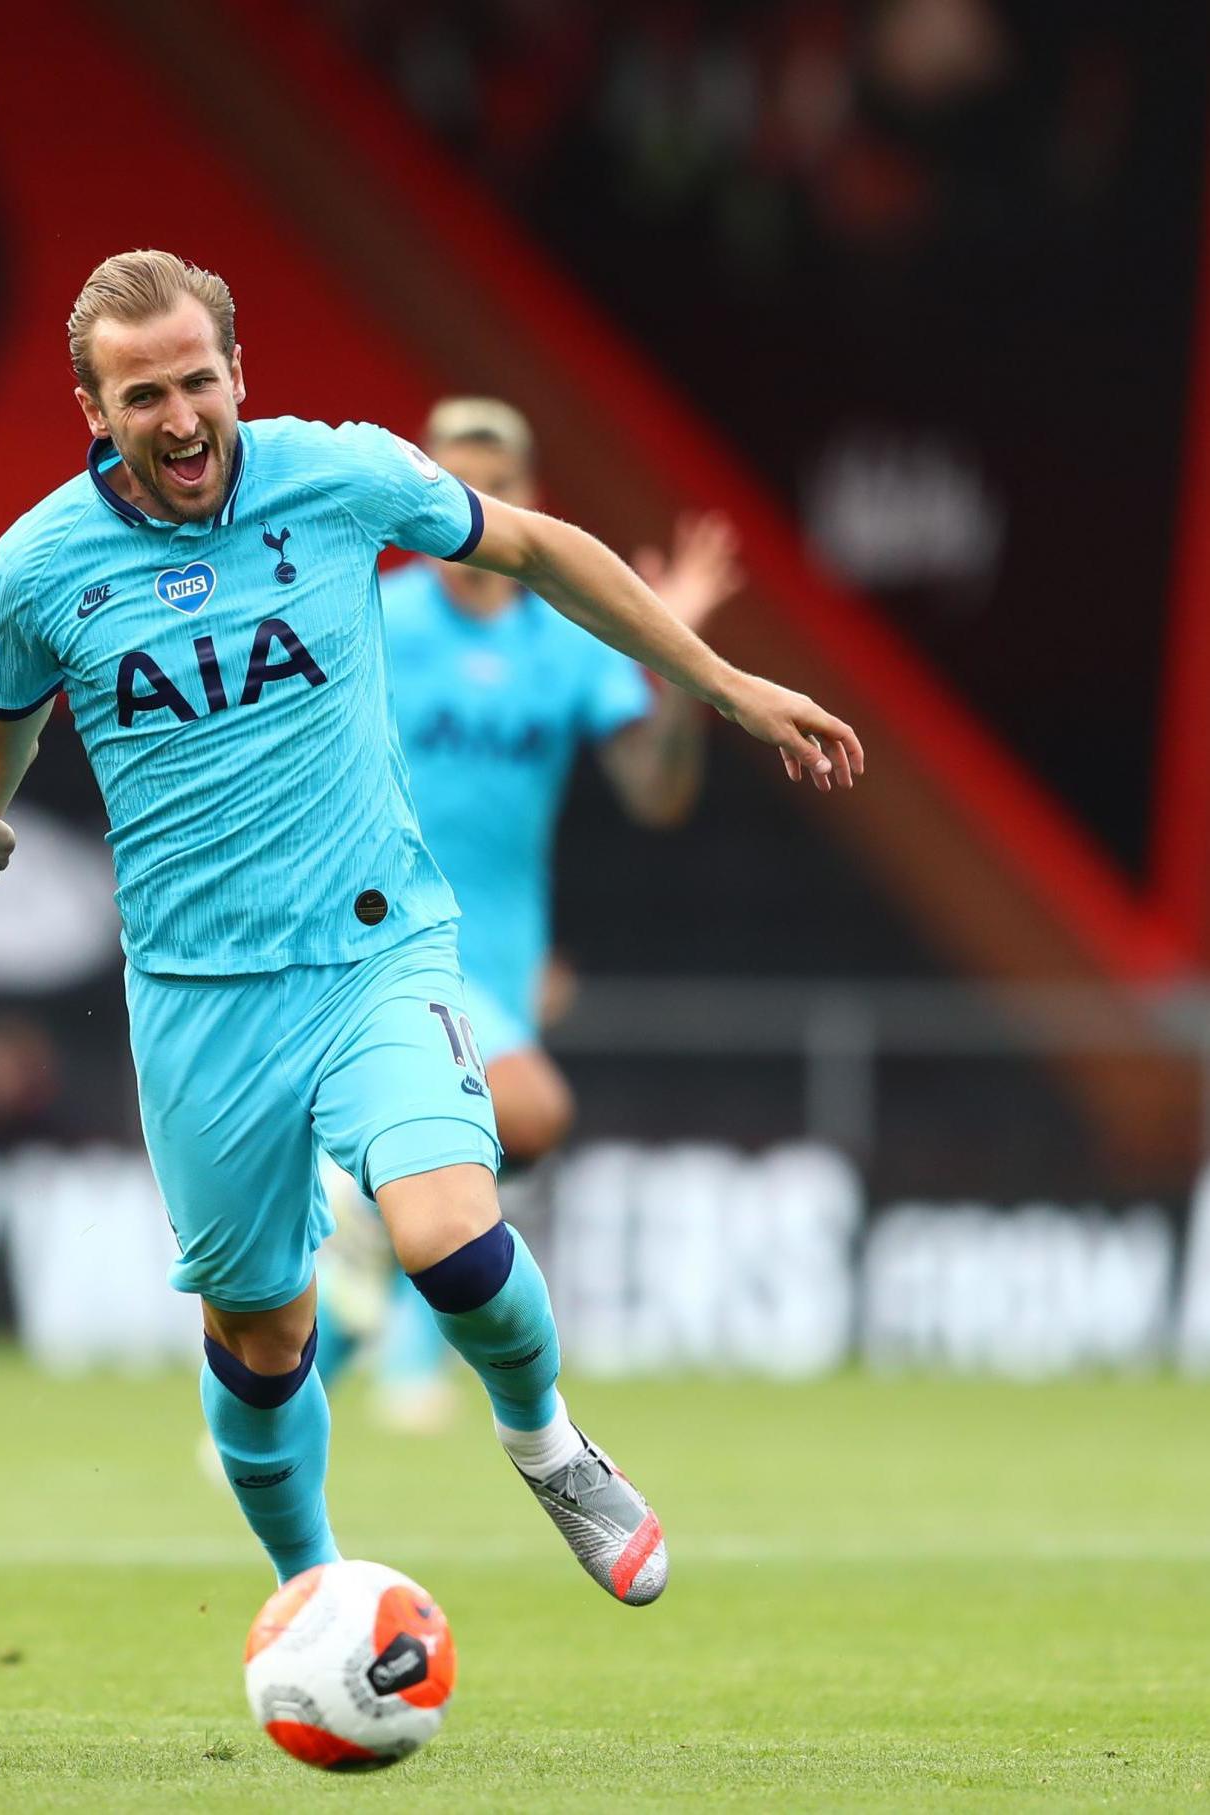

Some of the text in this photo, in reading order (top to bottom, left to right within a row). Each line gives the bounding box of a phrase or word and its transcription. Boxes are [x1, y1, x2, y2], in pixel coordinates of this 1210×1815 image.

[82, 583, 112, 606] NIKE
[169, 577, 205, 598] NHS
[115, 617, 329, 729] AIA
